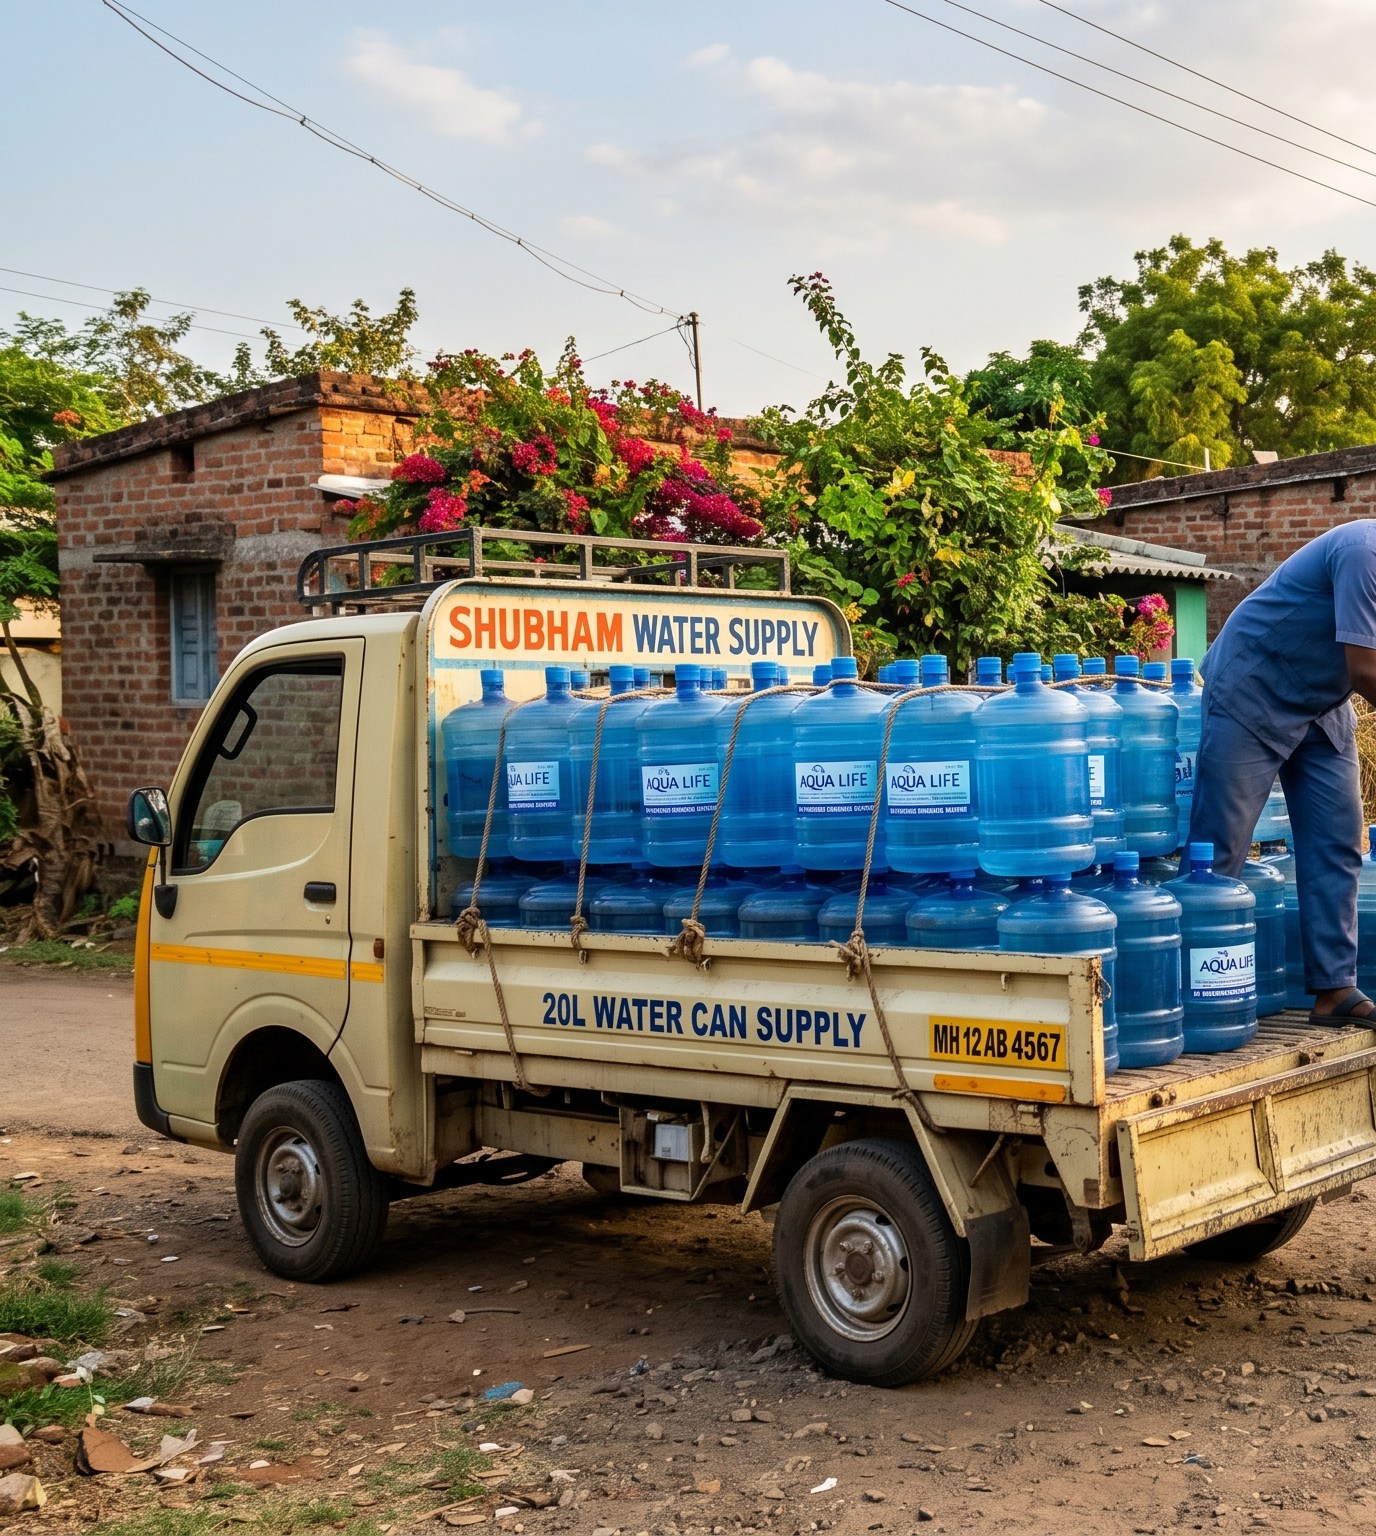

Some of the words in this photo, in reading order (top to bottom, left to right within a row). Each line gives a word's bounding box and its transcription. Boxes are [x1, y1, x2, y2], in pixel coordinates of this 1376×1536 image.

[449, 605, 623, 652] SHUBHAM
[632, 613, 721, 655] WATER
[728, 617, 819, 657] SUPPLY
[525, 772, 549, 785] LIFE
[646, 777, 679, 792] AQUA
[683, 774, 711, 788] LIFE
[800, 774, 835, 791] AQUA
[839, 772, 868, 787] LIFE
[891, 775, 926, 792] AQUA
[931, 773, 960, 788] LIFE
[1200, 957, 1237, 974] AQUA
[542, 992, 586, 1027] 20L
[593, 995, 684, 1035] WATER
[691, 1001, 747, 1039] CAN
[756, 1006, 867, 1048] SUPPLY
[934, 1024, 960, 1055] MH
[963, 1027, 982, 1056] 12
[984, 1028, 1008, 1058] AB
[1011, 1030, 1061, 1062] 4567
